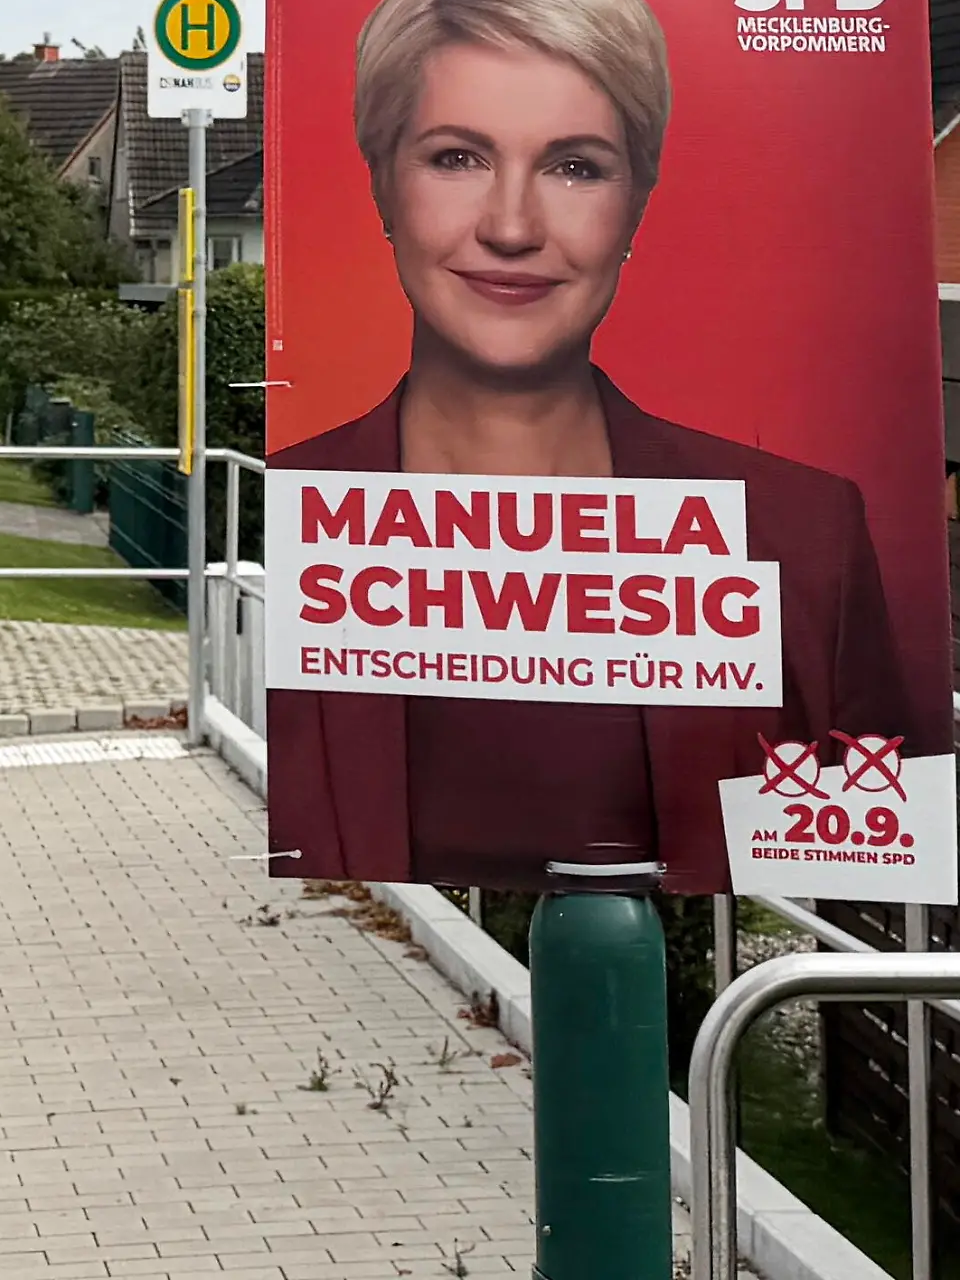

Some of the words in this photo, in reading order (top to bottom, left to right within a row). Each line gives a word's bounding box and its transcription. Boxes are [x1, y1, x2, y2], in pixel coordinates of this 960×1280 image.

[181, 4, 215, 50] H
[737, 17, 890, 33] MECKLENBURG-
[738, 35, 886, 52] VORPOMMERN
[301, 486, 730, 556] MANUELA
[298, 563, 761, 638] SCHWESIG
[300, 645, 594, 687] ENTSCHEIDUNG
[607, 652, 682, 690] FÜR
[695, 660, 763, 691] MV.
[751, 829, 778, 843] AM
[783, 804, 914, 848] 20.9.
[751, 847, 800, 861] BEIDE
[803, 849, 878, 864] STIMMEN
[882, 853, 916, 866] SPD
